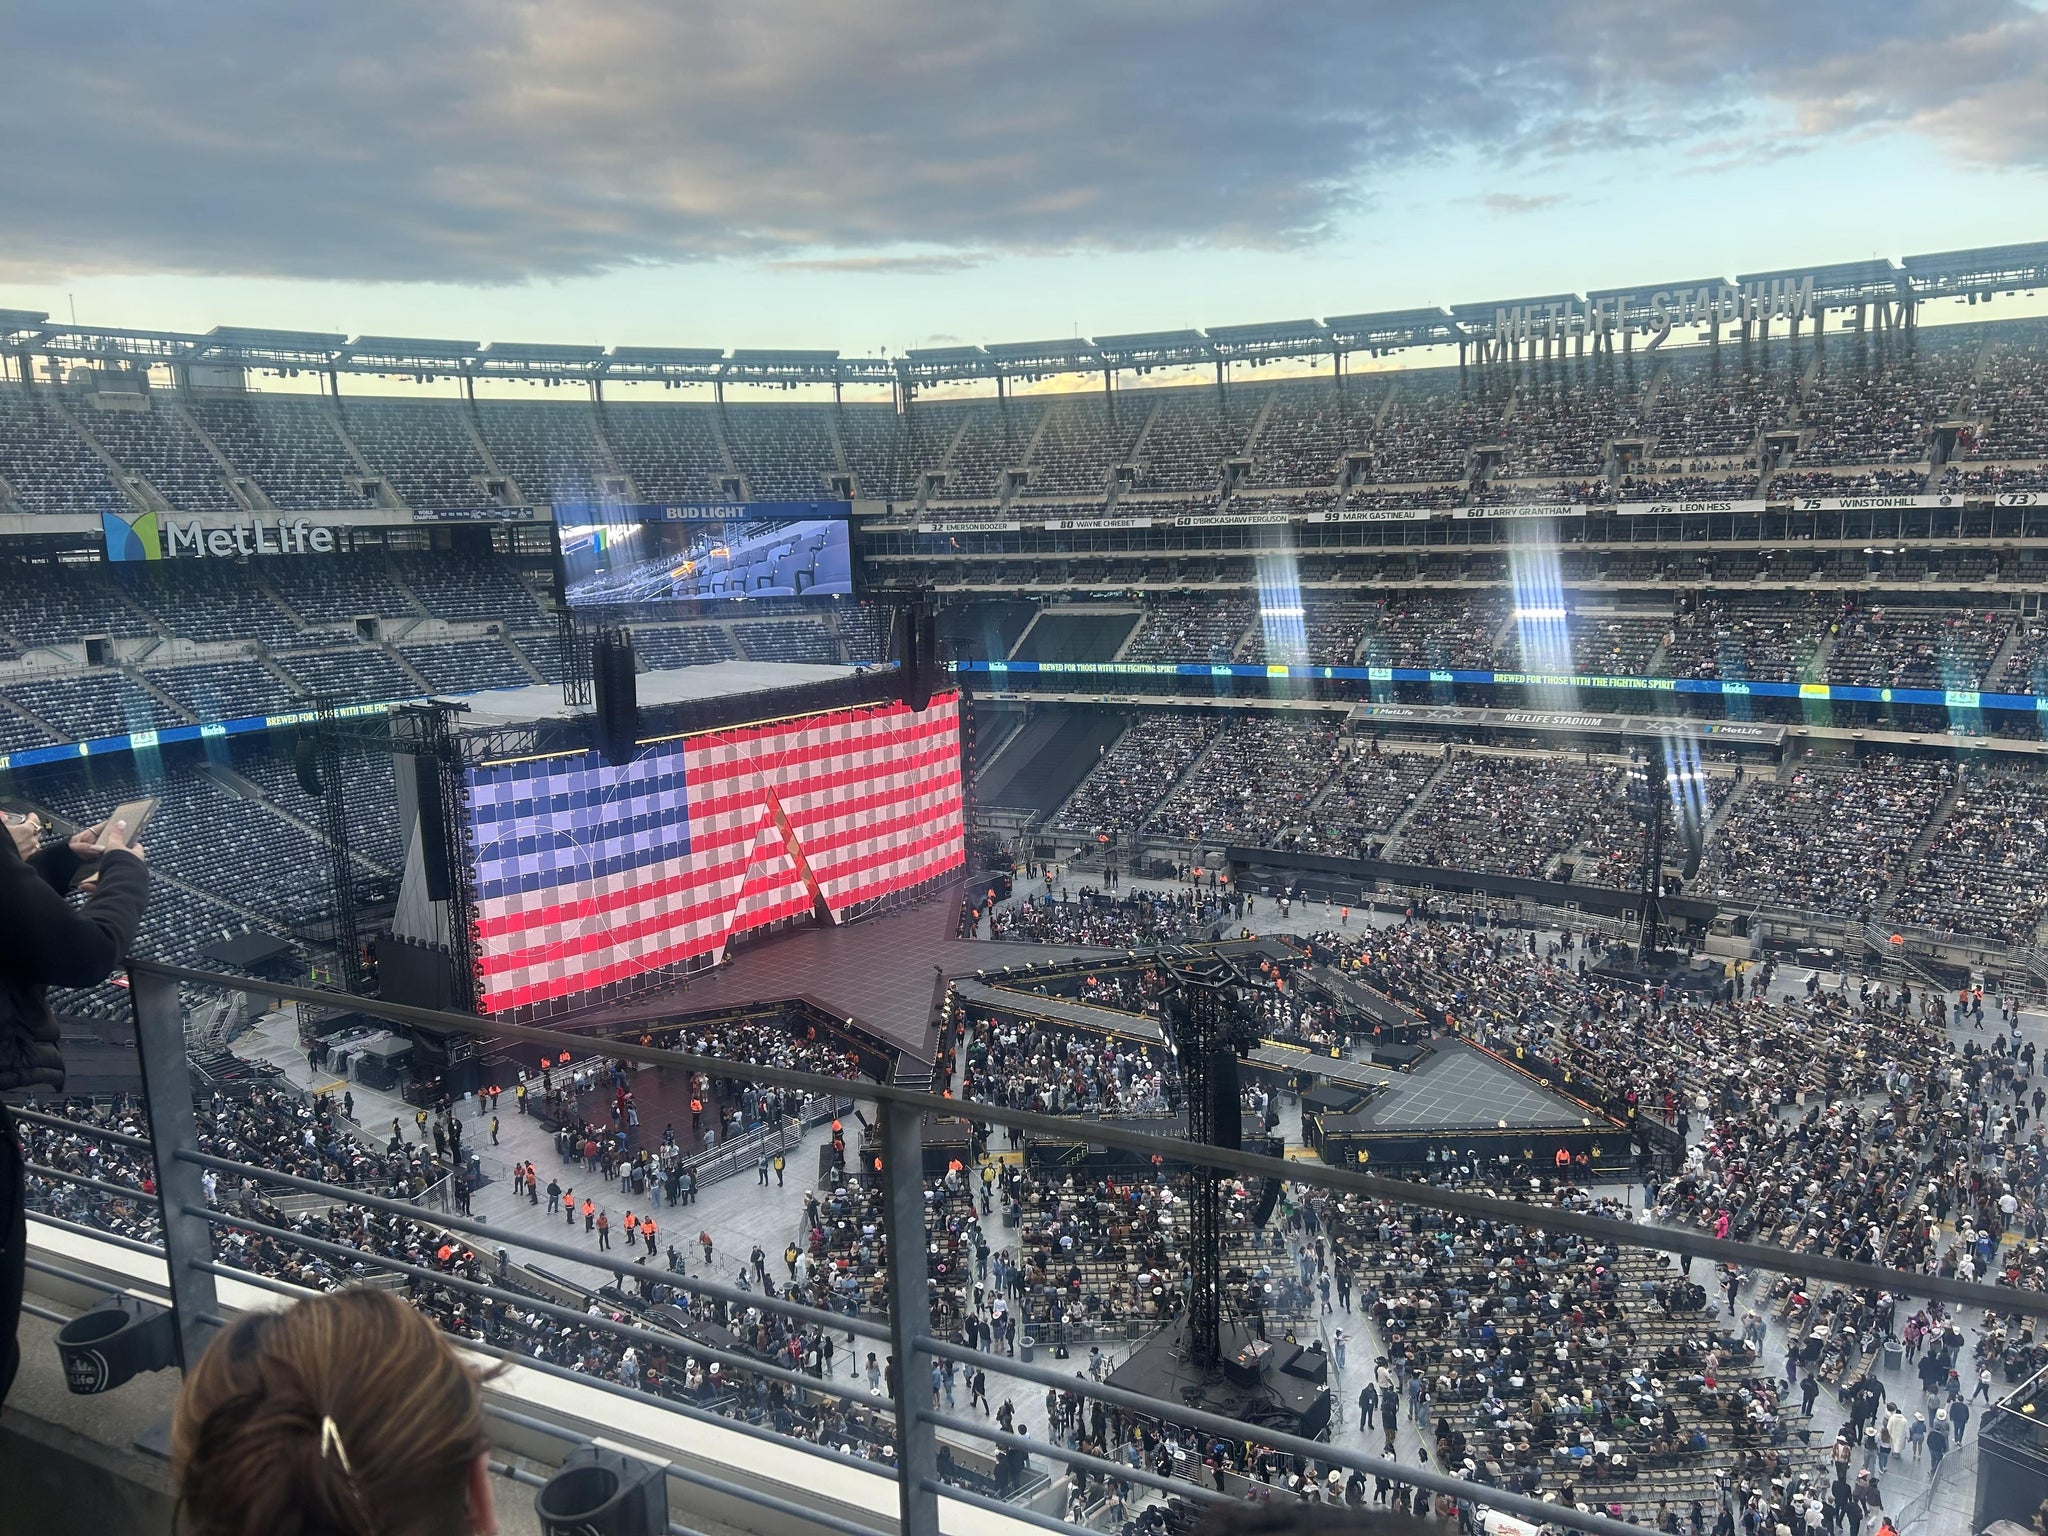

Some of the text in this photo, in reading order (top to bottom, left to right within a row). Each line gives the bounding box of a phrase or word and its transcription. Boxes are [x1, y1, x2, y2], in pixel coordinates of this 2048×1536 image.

[1495, 275, 1814, 344] METLIFE STADIUM
[1680, 503, 1705, 512] LEON
[1707, 502, 1731, 511] HESS
[1802, 498, 1917, 509] 75 WINSTON HILL
[666, 506, 746, 519] BUD LIGHT
[1324, 511, 1415, 521] 99 MARK GASTINEAU
[1467, 506, 1571, 518] 60 LARRY GRANTHAM
[1060, 519, 1136, 529] 80 WAYNE CHREBET
[1177, 517, 1191, 526] 60
[1248, 514, 1287, 524] FERGUSON
[946, 523, 979, 531] EMERSON
[979, 523, 1008, 531] BOOZER
[165, 517, 333, 557] MetLife
[1039, 663, 1177, 673] BREWED FOR THOSE WITH THE FIGHTING SPIRIT
[1493, 673, 1675, 690] BREWED FOR THOSE WITH THE FIGHTING SPIRIT
[1722, 682, 1750, 694] Modelo
[266, 715, 298, 726] BREWED
[299, 712, 314, 723] FOR
[339, 706, 359, 717] WITH
[359, 704, 373, 714] THE
[1379, 708, 1414, 716] MetLife
[1504, 713, 1602, 726] METLIFE STADIUM
[201, 724, 226, 737] Modelo
[1721, 726, 1762, 735] MetLife
